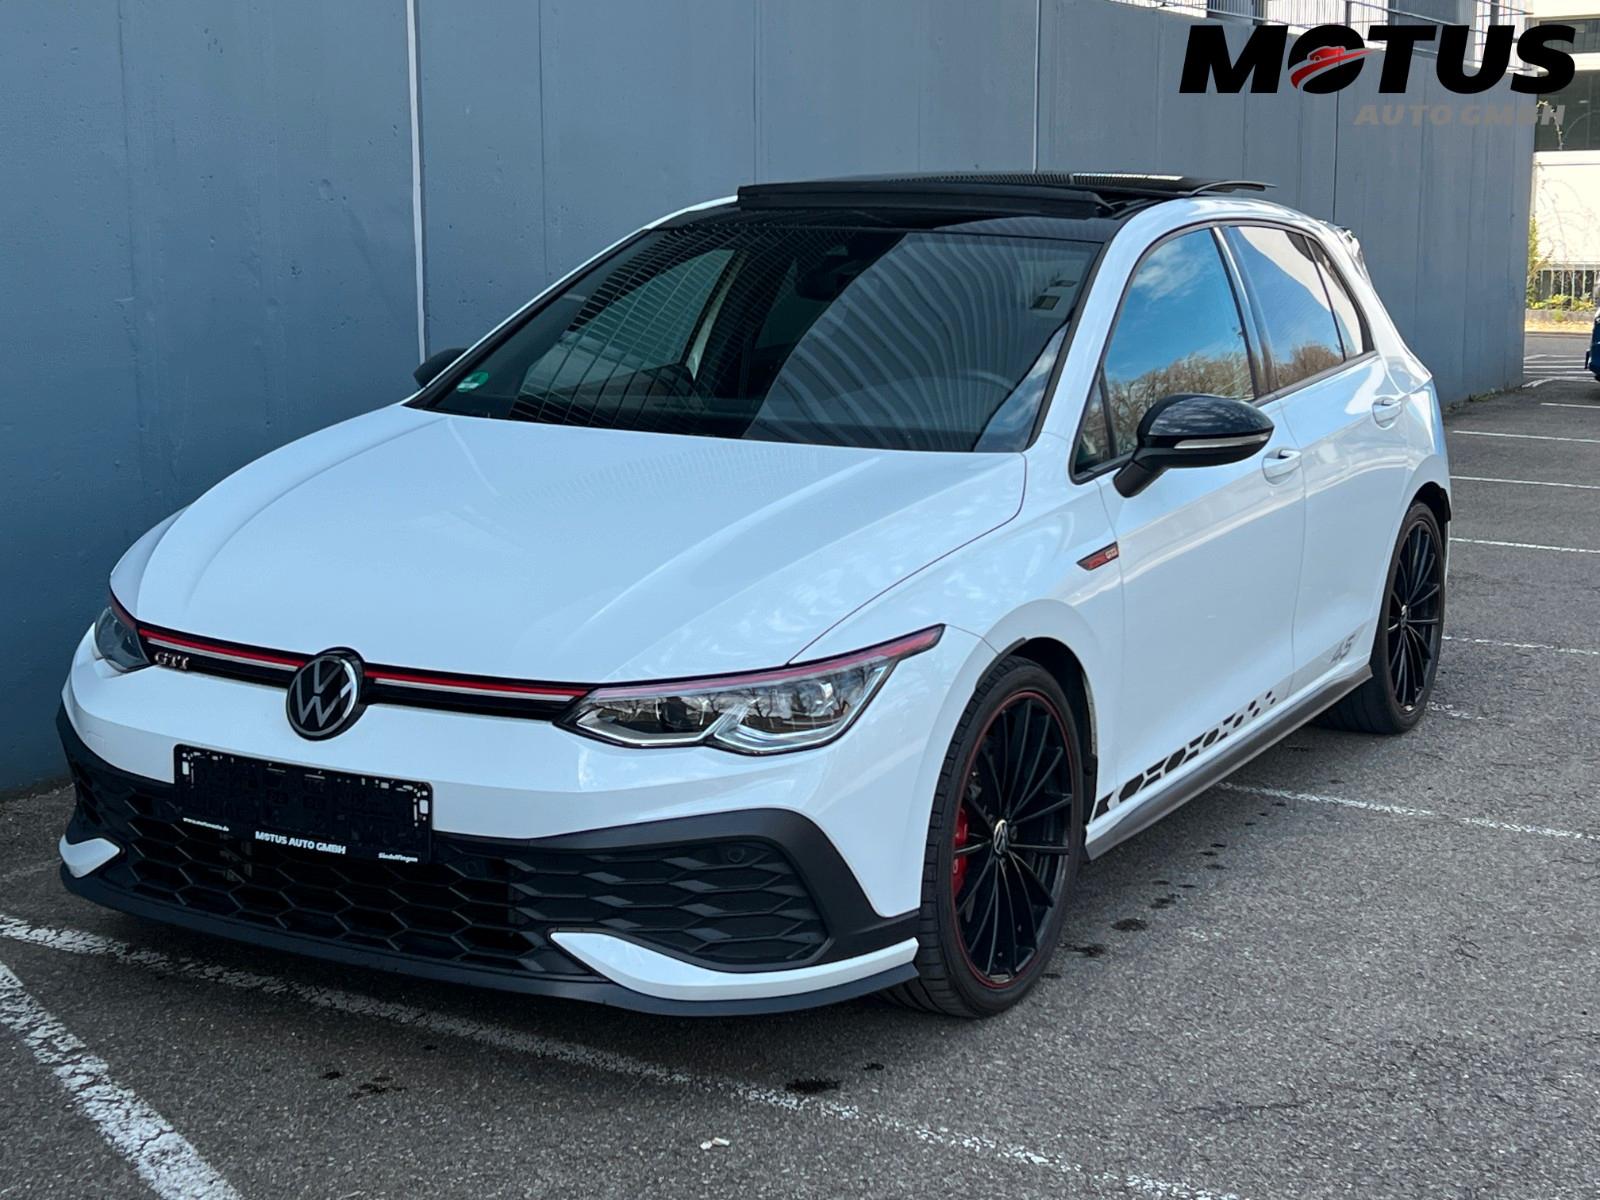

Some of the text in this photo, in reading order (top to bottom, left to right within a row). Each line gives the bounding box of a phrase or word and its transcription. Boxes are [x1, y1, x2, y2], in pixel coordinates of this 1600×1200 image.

[154, 651, 190, 670] GTI
[255, 830, 287, 845] MOTUS
[288, 837, 315, 850] AUTO
